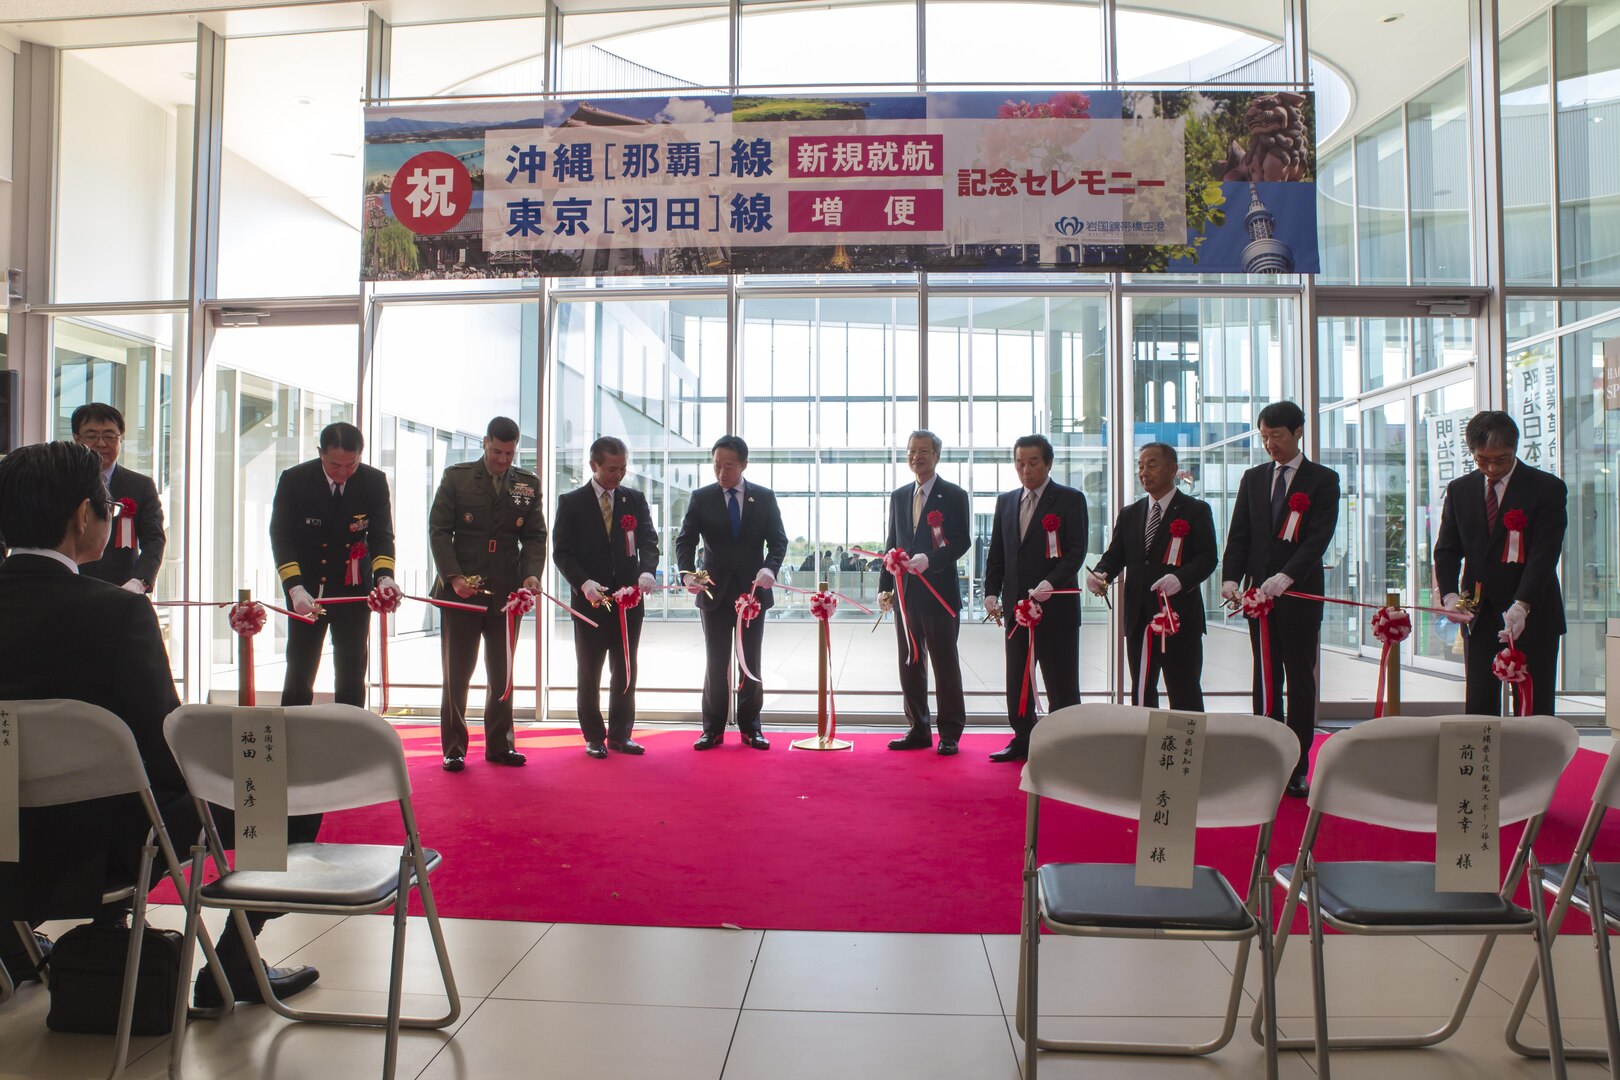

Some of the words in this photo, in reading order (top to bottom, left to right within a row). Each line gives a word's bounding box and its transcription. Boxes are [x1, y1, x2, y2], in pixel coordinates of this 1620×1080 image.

[797, 139, 935, 173] 新規就航
[404, 167, 457, 220] 祝
[957, 168, 1166, 198] 記念セレモニー
[1459, 744, 1476, 777] 前田
[1457, 799, 1474, 833] 光幸
[243, 825, 258, 839] 様
[1150, 847, 1166, 864] 様
[1456, 853, 1473, 870] 様
